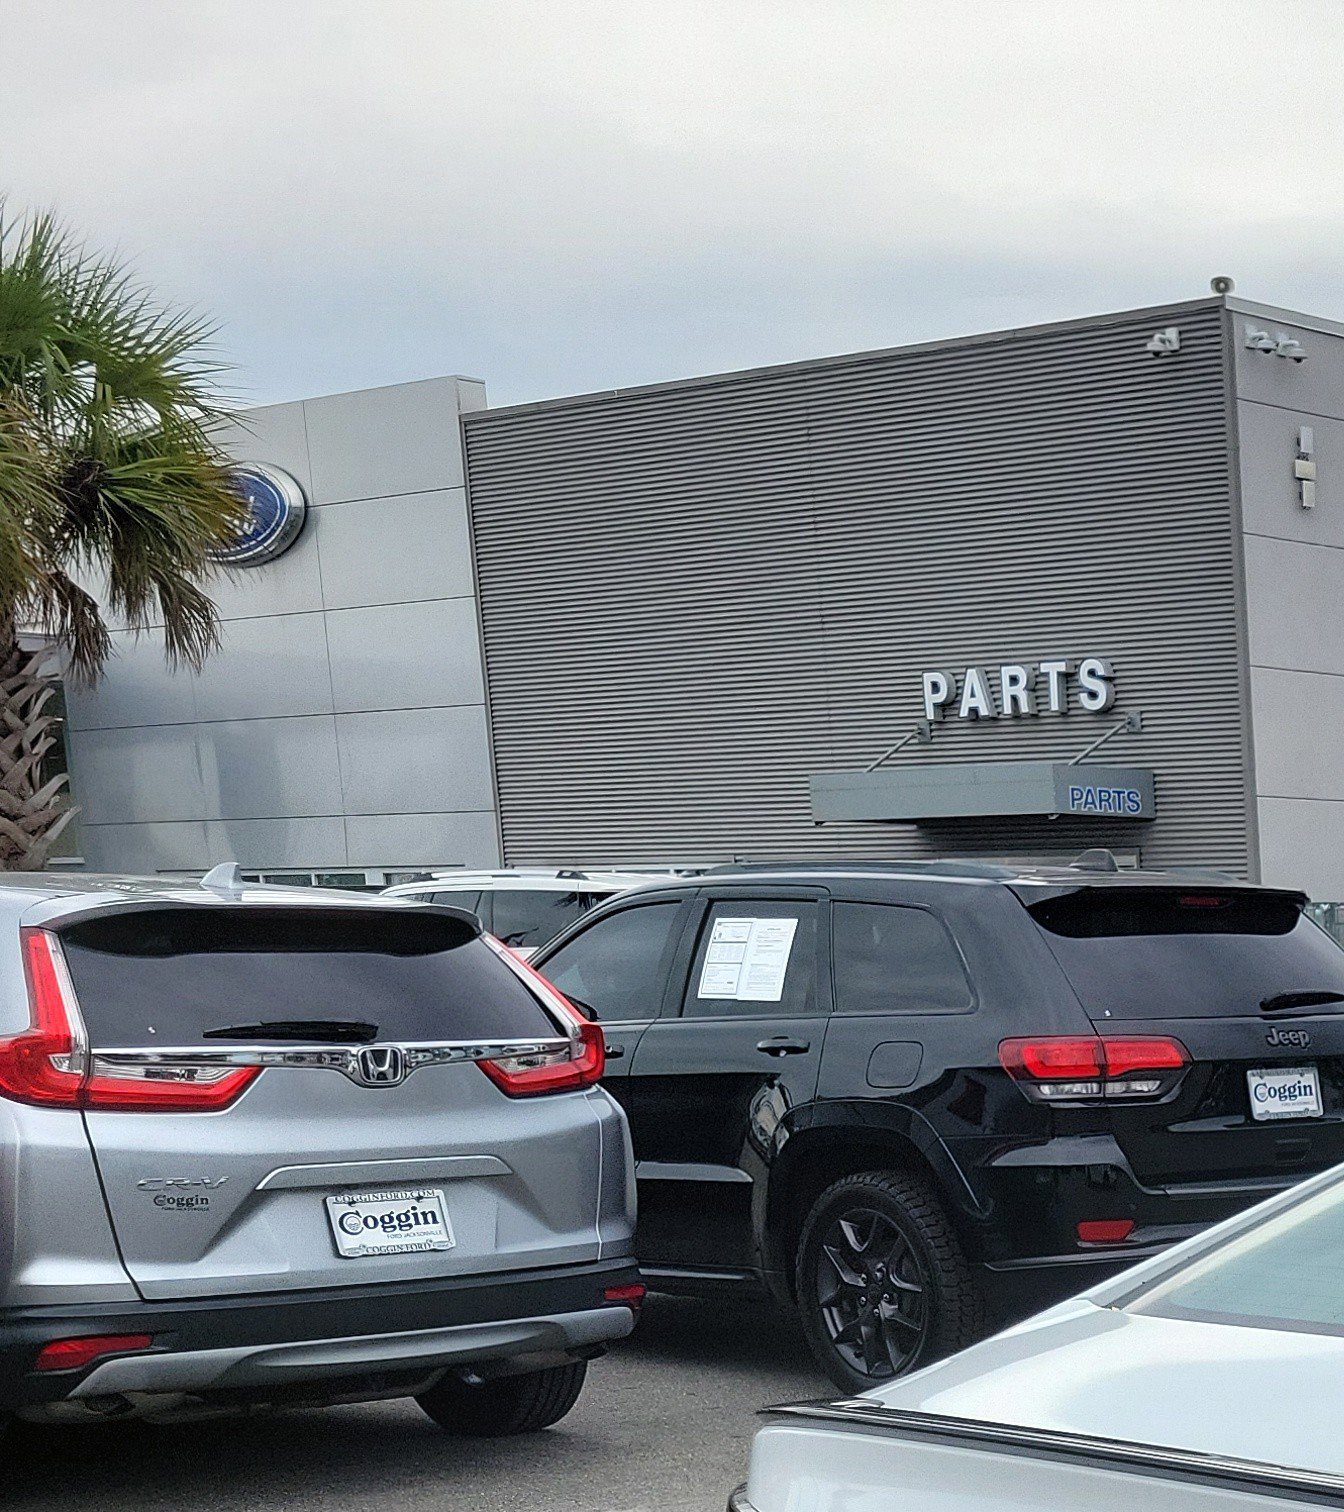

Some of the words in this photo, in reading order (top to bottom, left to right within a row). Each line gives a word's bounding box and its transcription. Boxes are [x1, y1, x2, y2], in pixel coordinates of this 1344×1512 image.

[922, 659, 1115, 721] PARTS
[1069, 786, 1142, 814] PARTS
[1266, 1026, 1310, 1048] Jeep
[1254, 1080, 1313, 1102] Coggin
[137, 1175, 229, 1192] CR-V
[153, 1194, 209, 1208] Coggin
[334, 1189, 435, 1204] COGGINFORD.COM
[338, 1205, 440, 1236] Coggin
[366, 1244, 404, 1254] COGGIN
[405, 1242, 431, 1251] FORD
